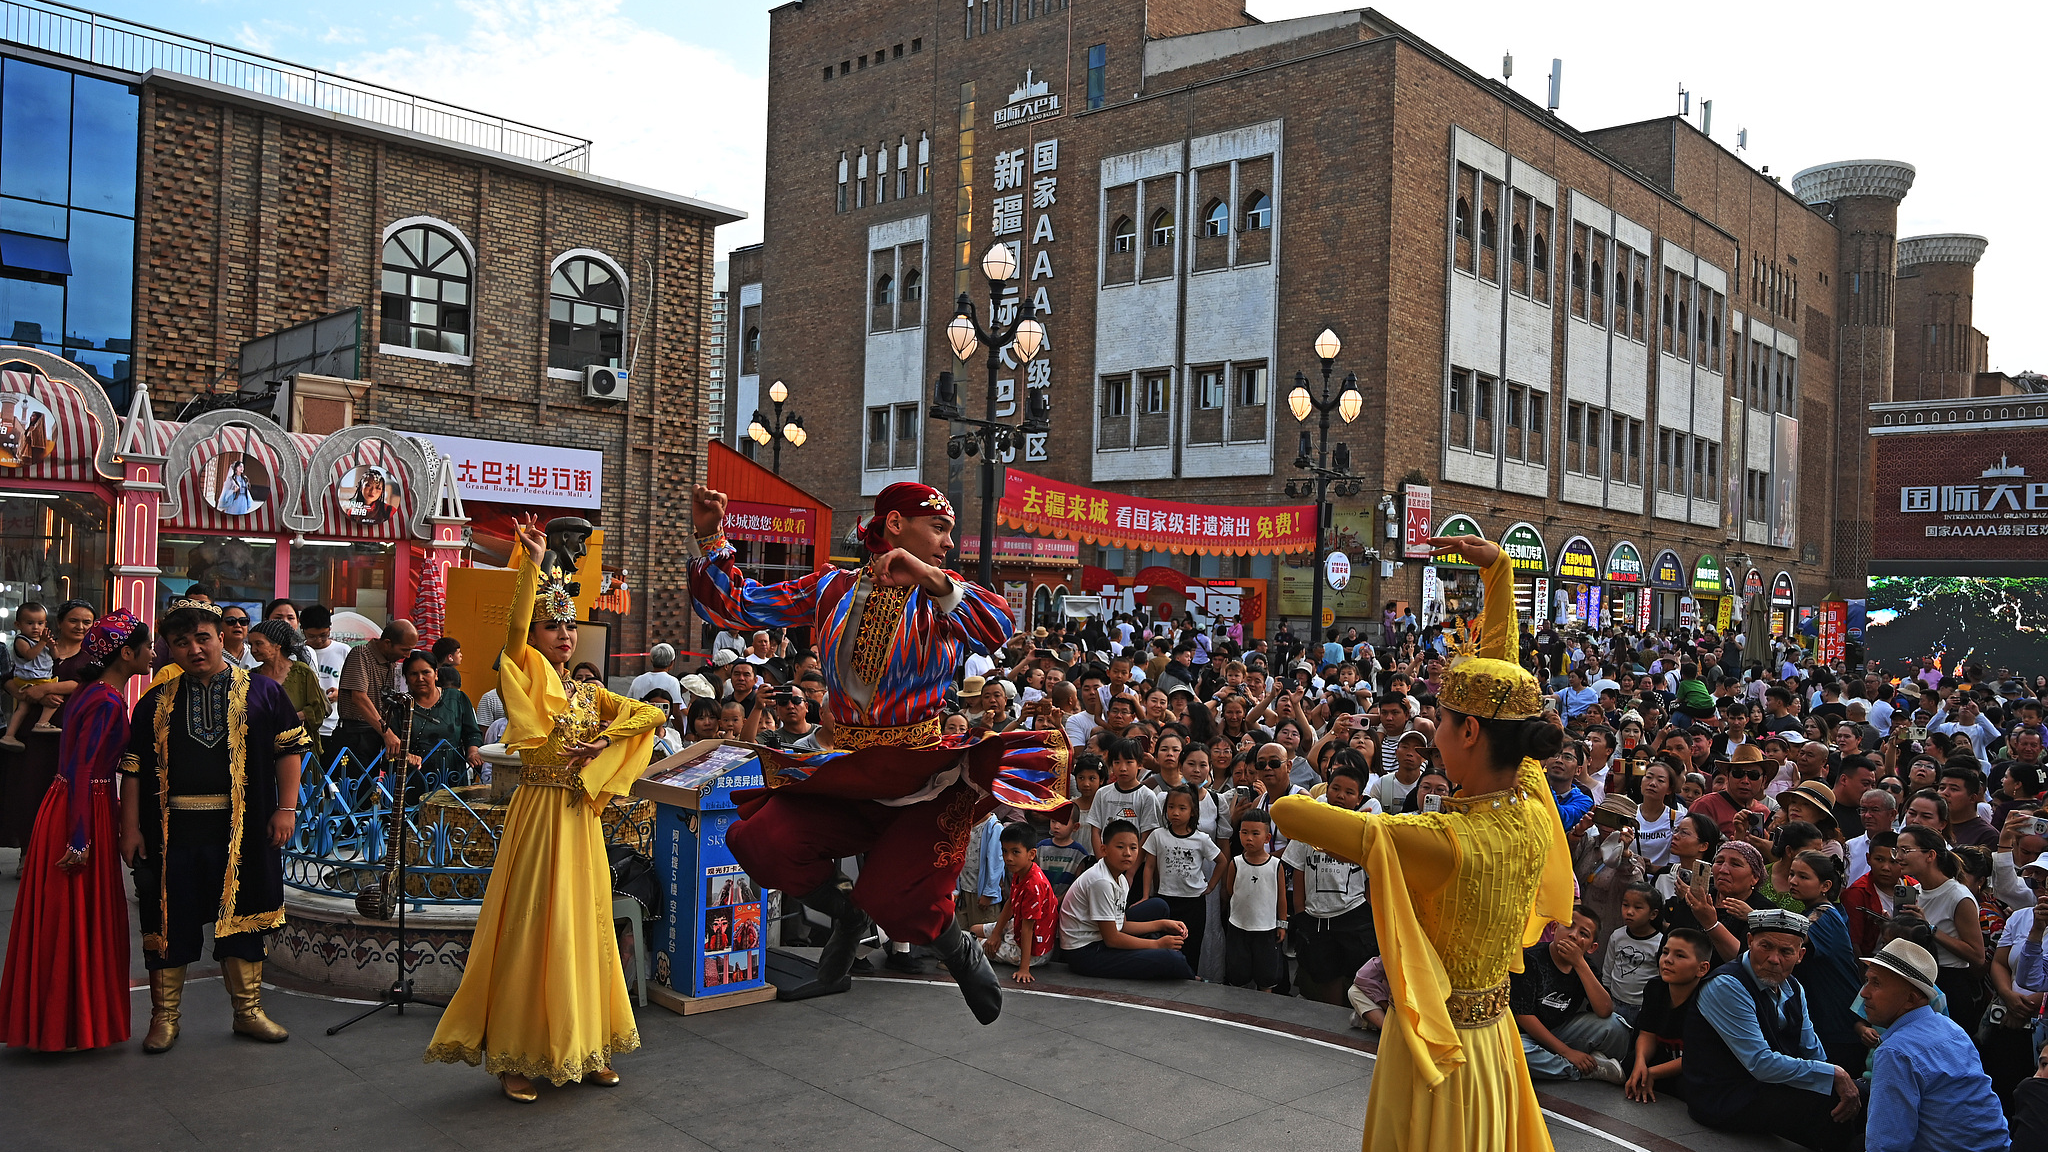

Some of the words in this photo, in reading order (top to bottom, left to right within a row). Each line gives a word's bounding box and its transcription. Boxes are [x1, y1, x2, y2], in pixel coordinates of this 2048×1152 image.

[994, 95, 1062, 124] 国际大巴扎
[995, 118, 1027, 130] INTERNATIONAL
[1027, 113, 1043, 122] GRAND
[1043, 109, 1060, 119] BAZAAR
[1025, 138, 1058, 462] 国家AAAA级区
[457, 459, 592, 492] 大巴扎步行街
[465, 482, 489, 491] Grand
[493, 484, 519, 493] Bazaar
[523, 487, 563, 497] Pedestrian
[567, 490, 583, 498] Mall
[1022, 485, 1109, 526] 去疆来城
[1115, 506, 1250, 537] 看国家级非遗演出
[1407, 510, 1416, 543] 入口
[1680, 602, 1691, 626] 和田
[1836, 632, 1846, 662] 演艺
[319, 664, 339, 678] ING
